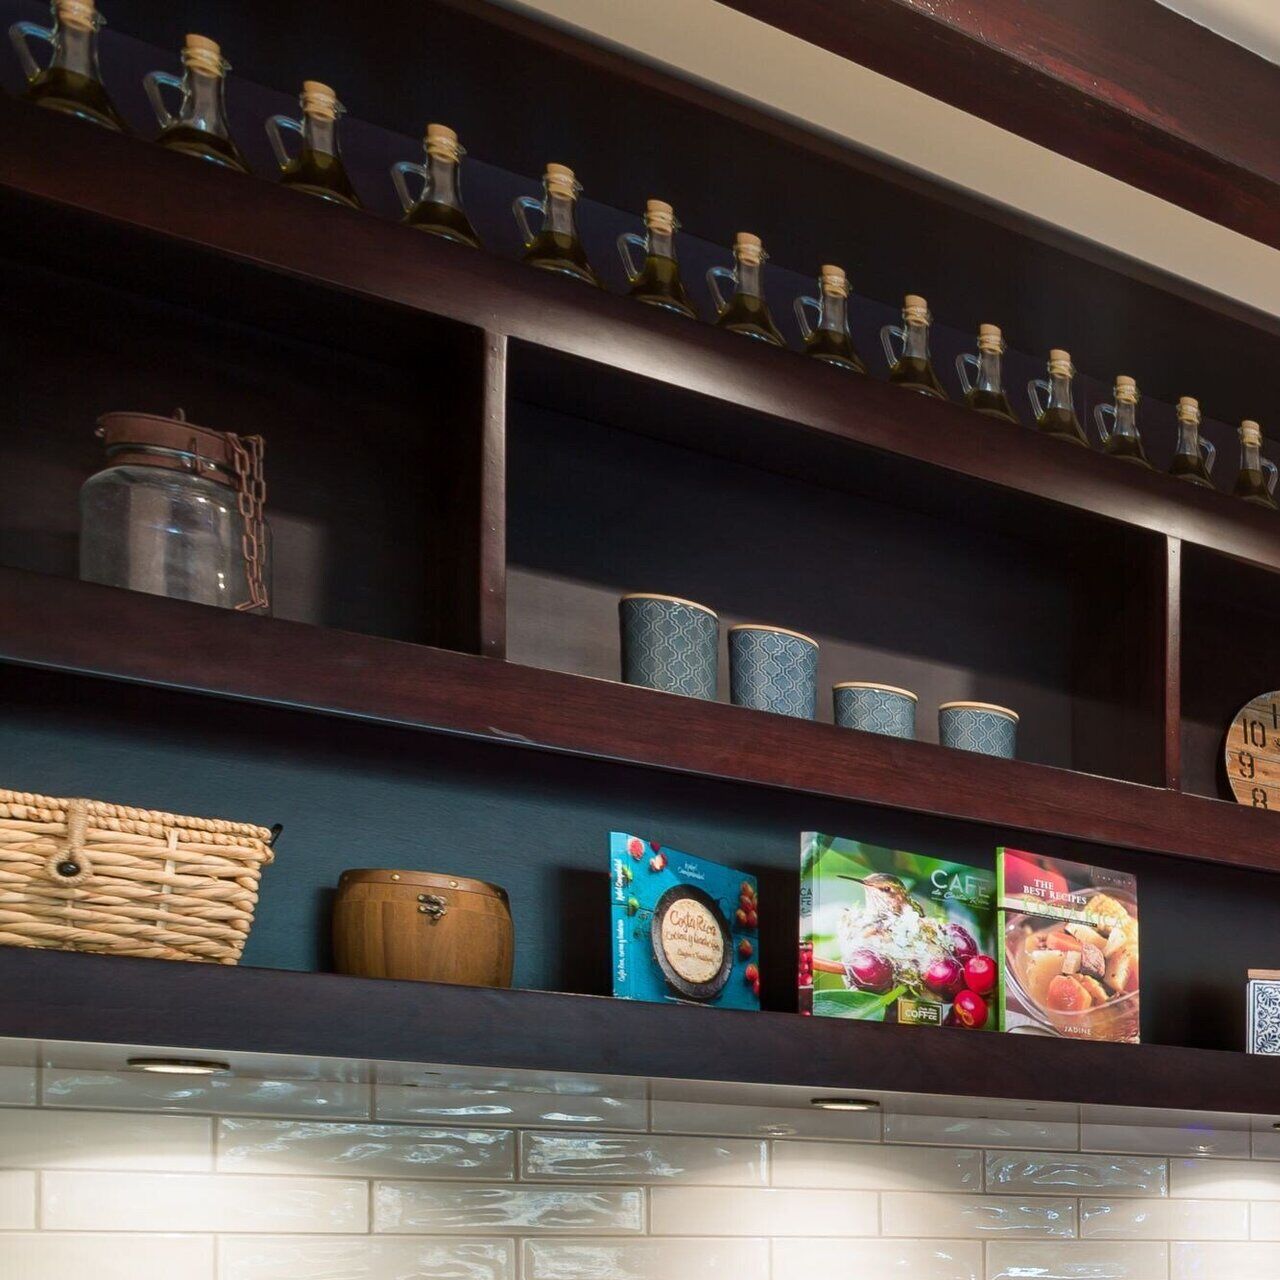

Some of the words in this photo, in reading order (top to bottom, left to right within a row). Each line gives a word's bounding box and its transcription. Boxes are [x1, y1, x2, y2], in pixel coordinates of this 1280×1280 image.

[1243, 718, 1266, 749] 10
[1238, 751, 1255, 779] 9
[1033, 878, 1055, 891] THE
[1023, 885, 1047, 897] BEST
[1049, 889, 1088, 905] RECIPES
[905, 1009, 938, 1022] COFFEE
